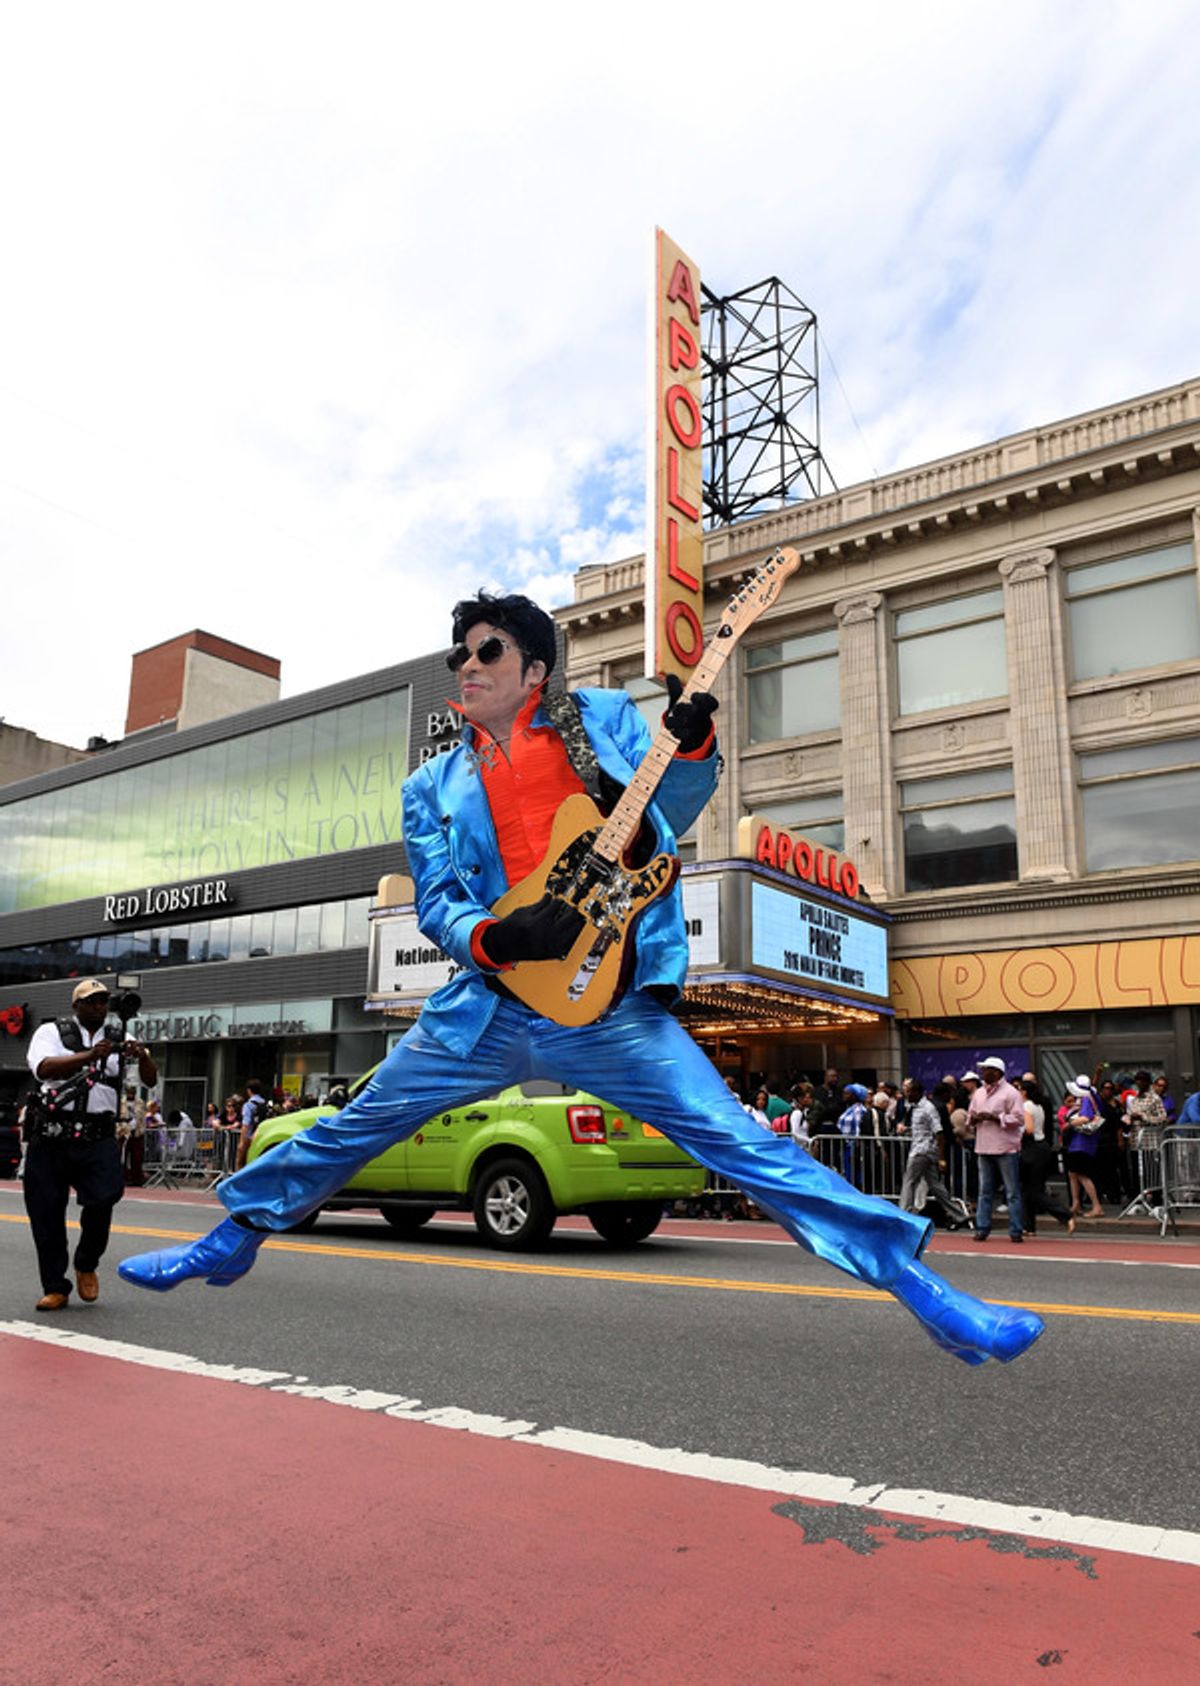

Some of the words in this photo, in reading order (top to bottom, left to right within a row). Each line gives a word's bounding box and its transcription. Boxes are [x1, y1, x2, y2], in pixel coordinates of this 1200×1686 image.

[665, 258, 704, 667] APOLLO
[301, 769, 322, 806] A
[264, 826, 297, 866] IN
[756, 825, 859, 898] APOLLO
[103, 895, 140, 922] RED
[143, 879, 229, 915] LOBSTER
[808, 926, 842, 963] PRINCE
[133, 1013, 223, 1043] REPUBLIC
